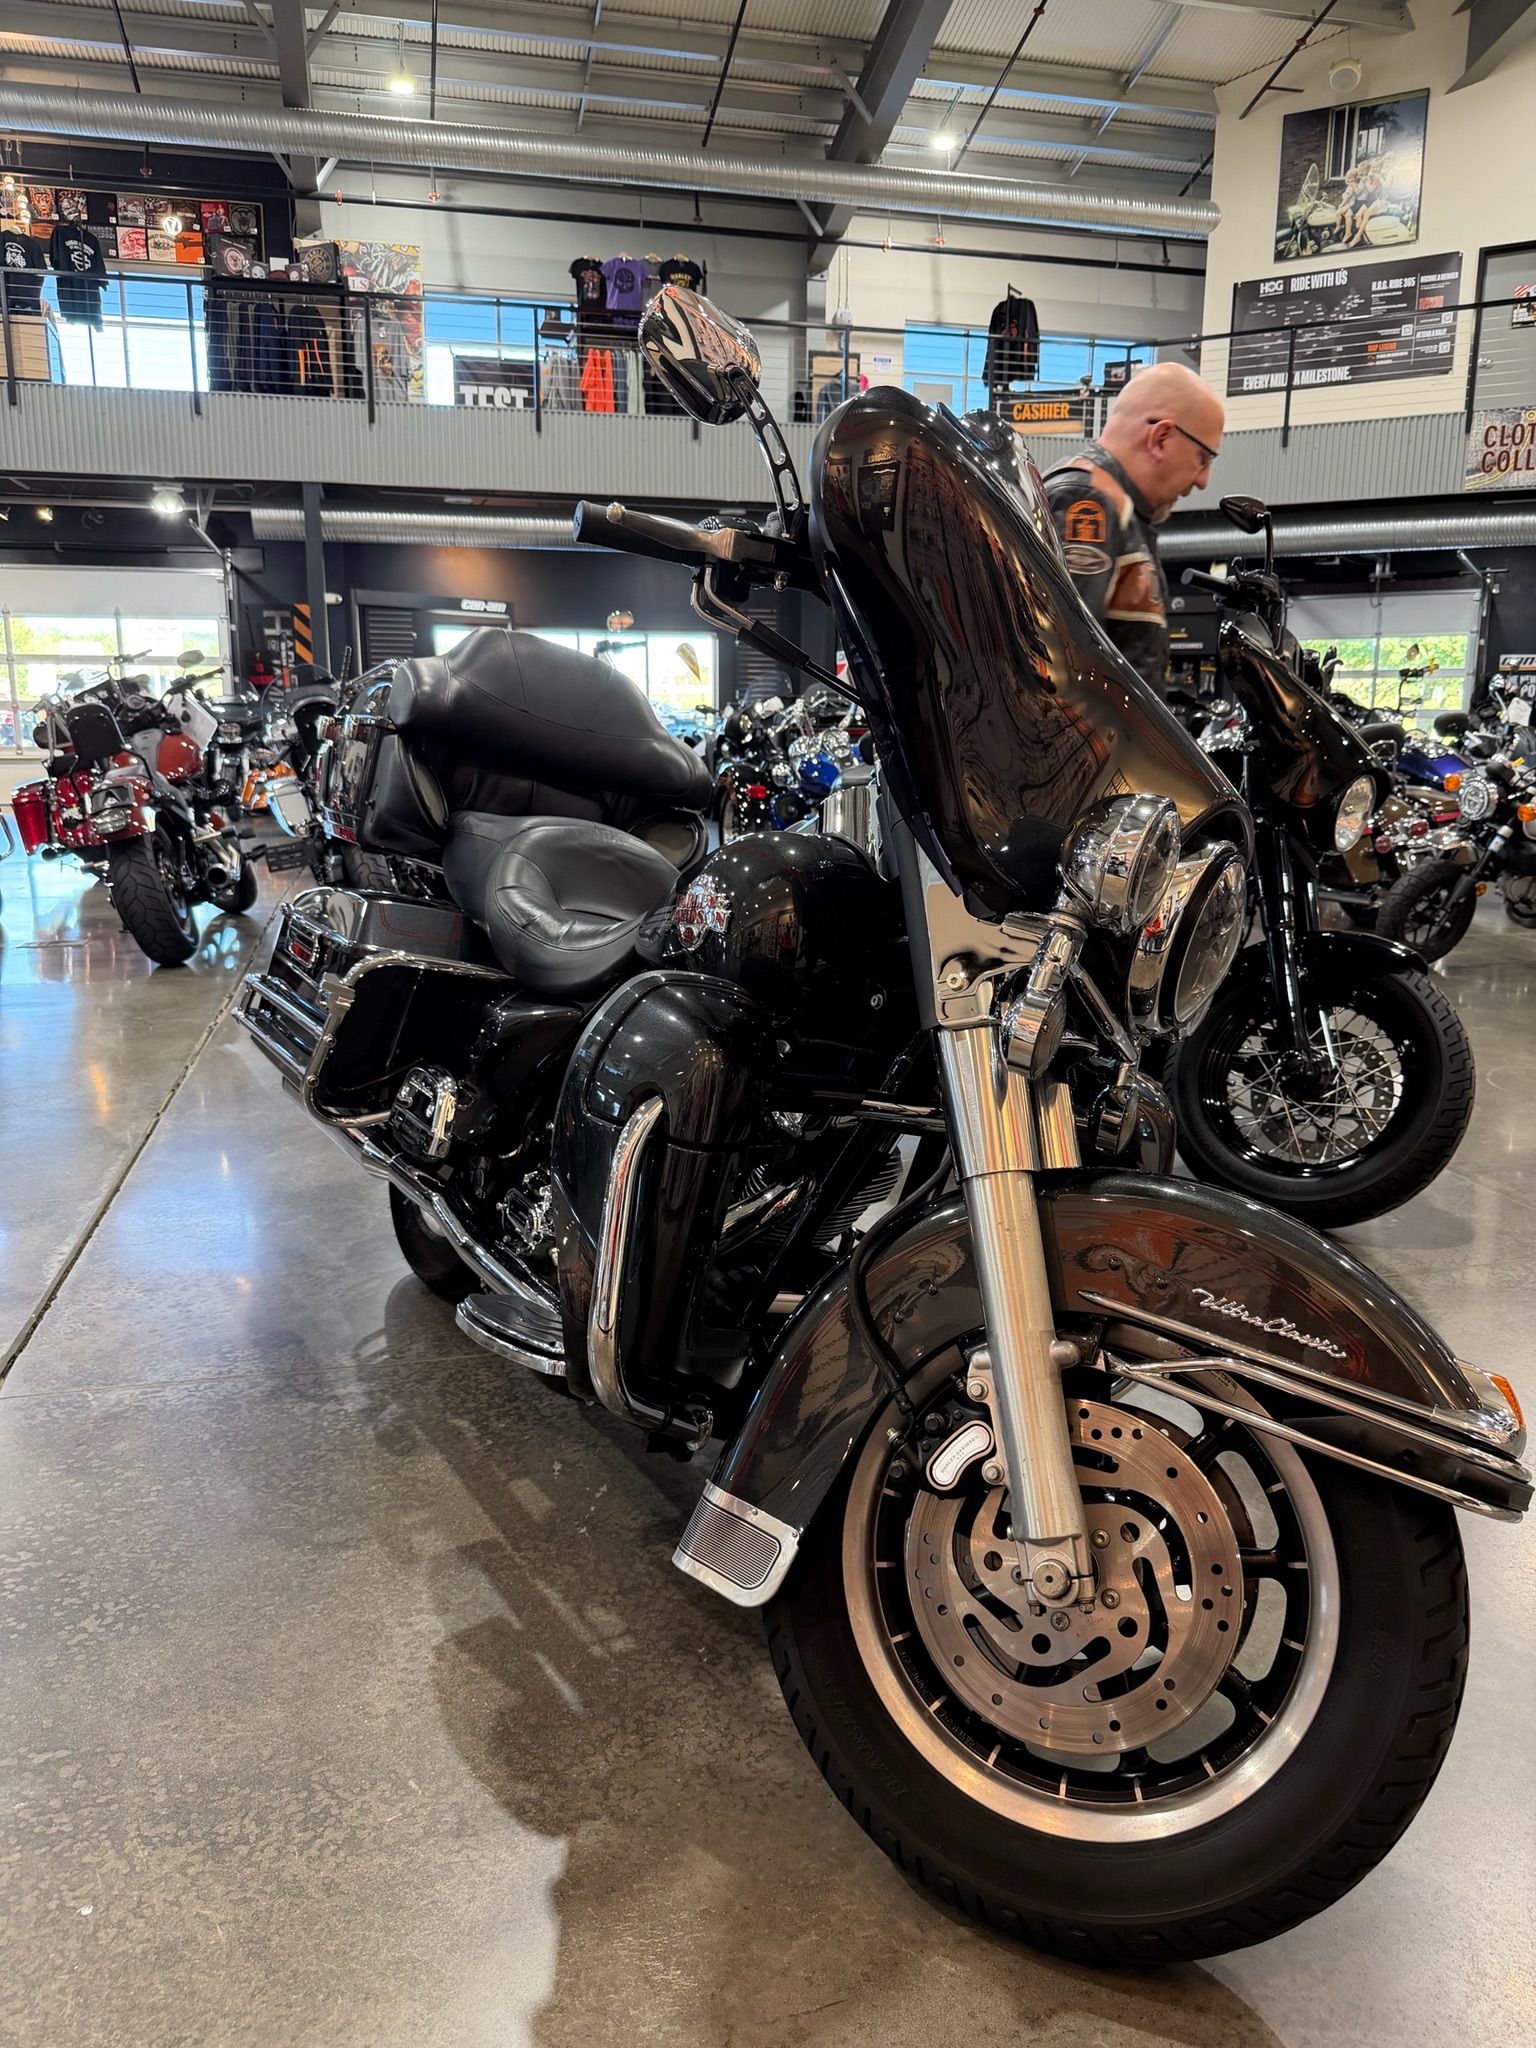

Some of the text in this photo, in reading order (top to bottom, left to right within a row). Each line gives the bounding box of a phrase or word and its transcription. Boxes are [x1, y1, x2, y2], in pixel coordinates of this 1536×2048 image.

[1290, 269, 1348, 293] RIDE WITH US
[1242, 373, 1269, 391] EVERY
[1269, 372, 1289, 389] MIL
[1012, 402, 1070, 421] CASHIER
[1481, 449, 1535, 474] COLL
